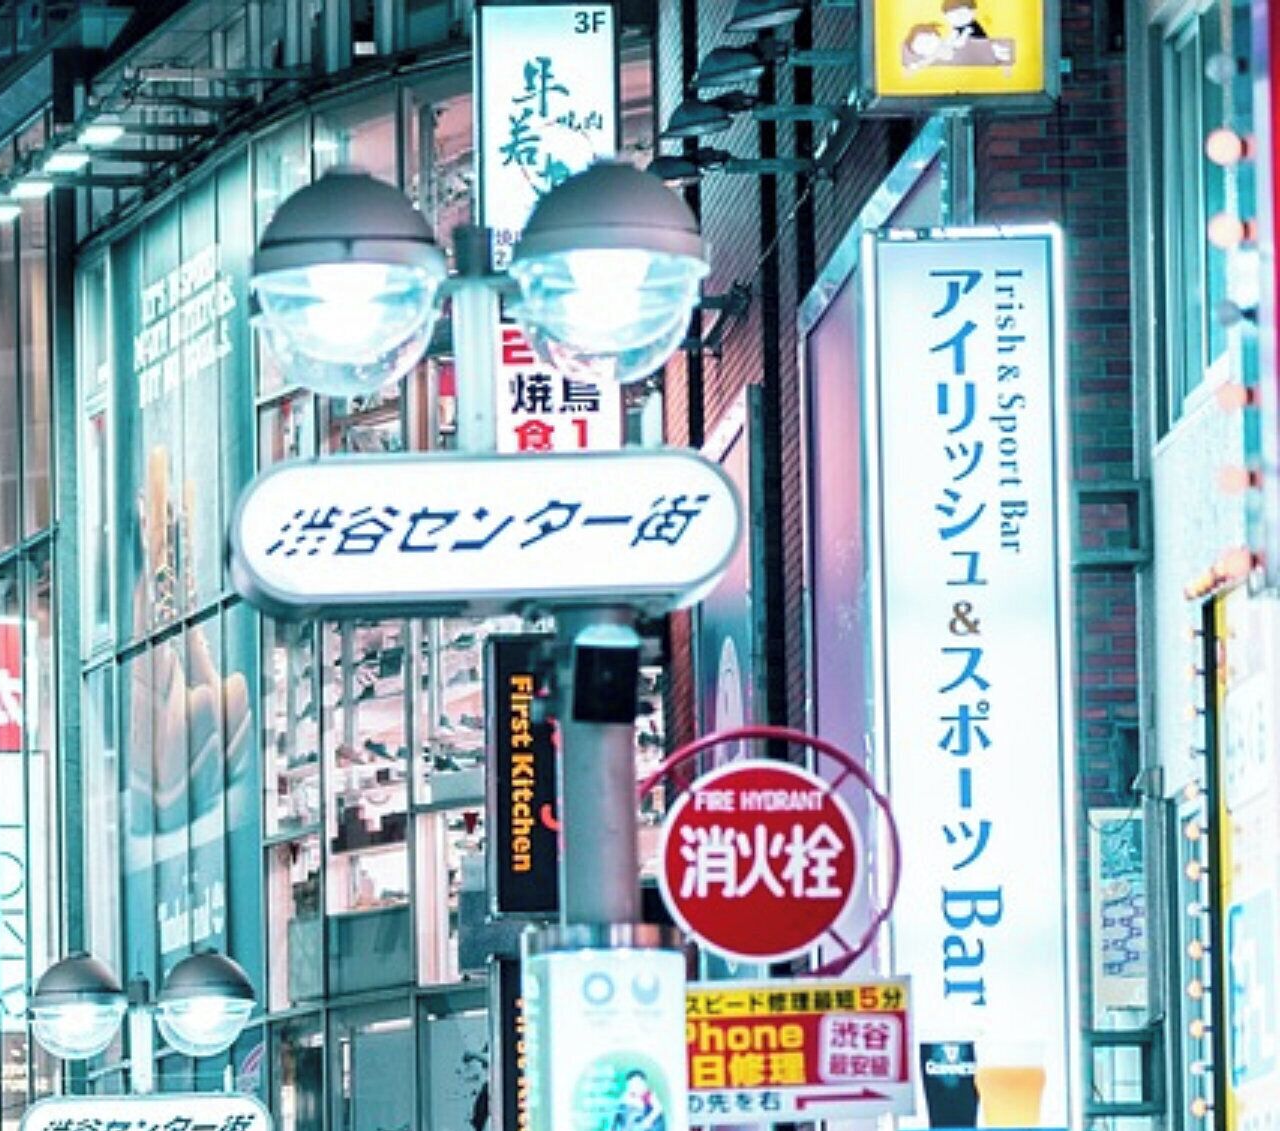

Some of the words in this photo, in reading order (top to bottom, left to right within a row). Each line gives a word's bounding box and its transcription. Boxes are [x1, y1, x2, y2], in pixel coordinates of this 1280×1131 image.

[574, 11, 606, 34] 3F
[994, 269, 1026, 352] Irish
[998, 365, 1019, 382] &
[929, 270, 987, 586] アイリッシュ
[989, 393, 1027, 485] Sport
[265, 494, 711, 559] 渋谷センター街
[999, 499, 1030, 555] Bar
[948, 603, 981, 636] &
[509, 674, 533, 747] First
[938, 647, 993, 872] スポーツ
[509, 751, 533, 871] Kitchen
[695, 792, 734, 811] FIRE
[741, 791, 824, 812] HYDRANT
[680, 823, 845, 899] 消火栓
[942, 886, 1003, 1006] Bar
[830, 1020, 890, 1050] 渋谷
